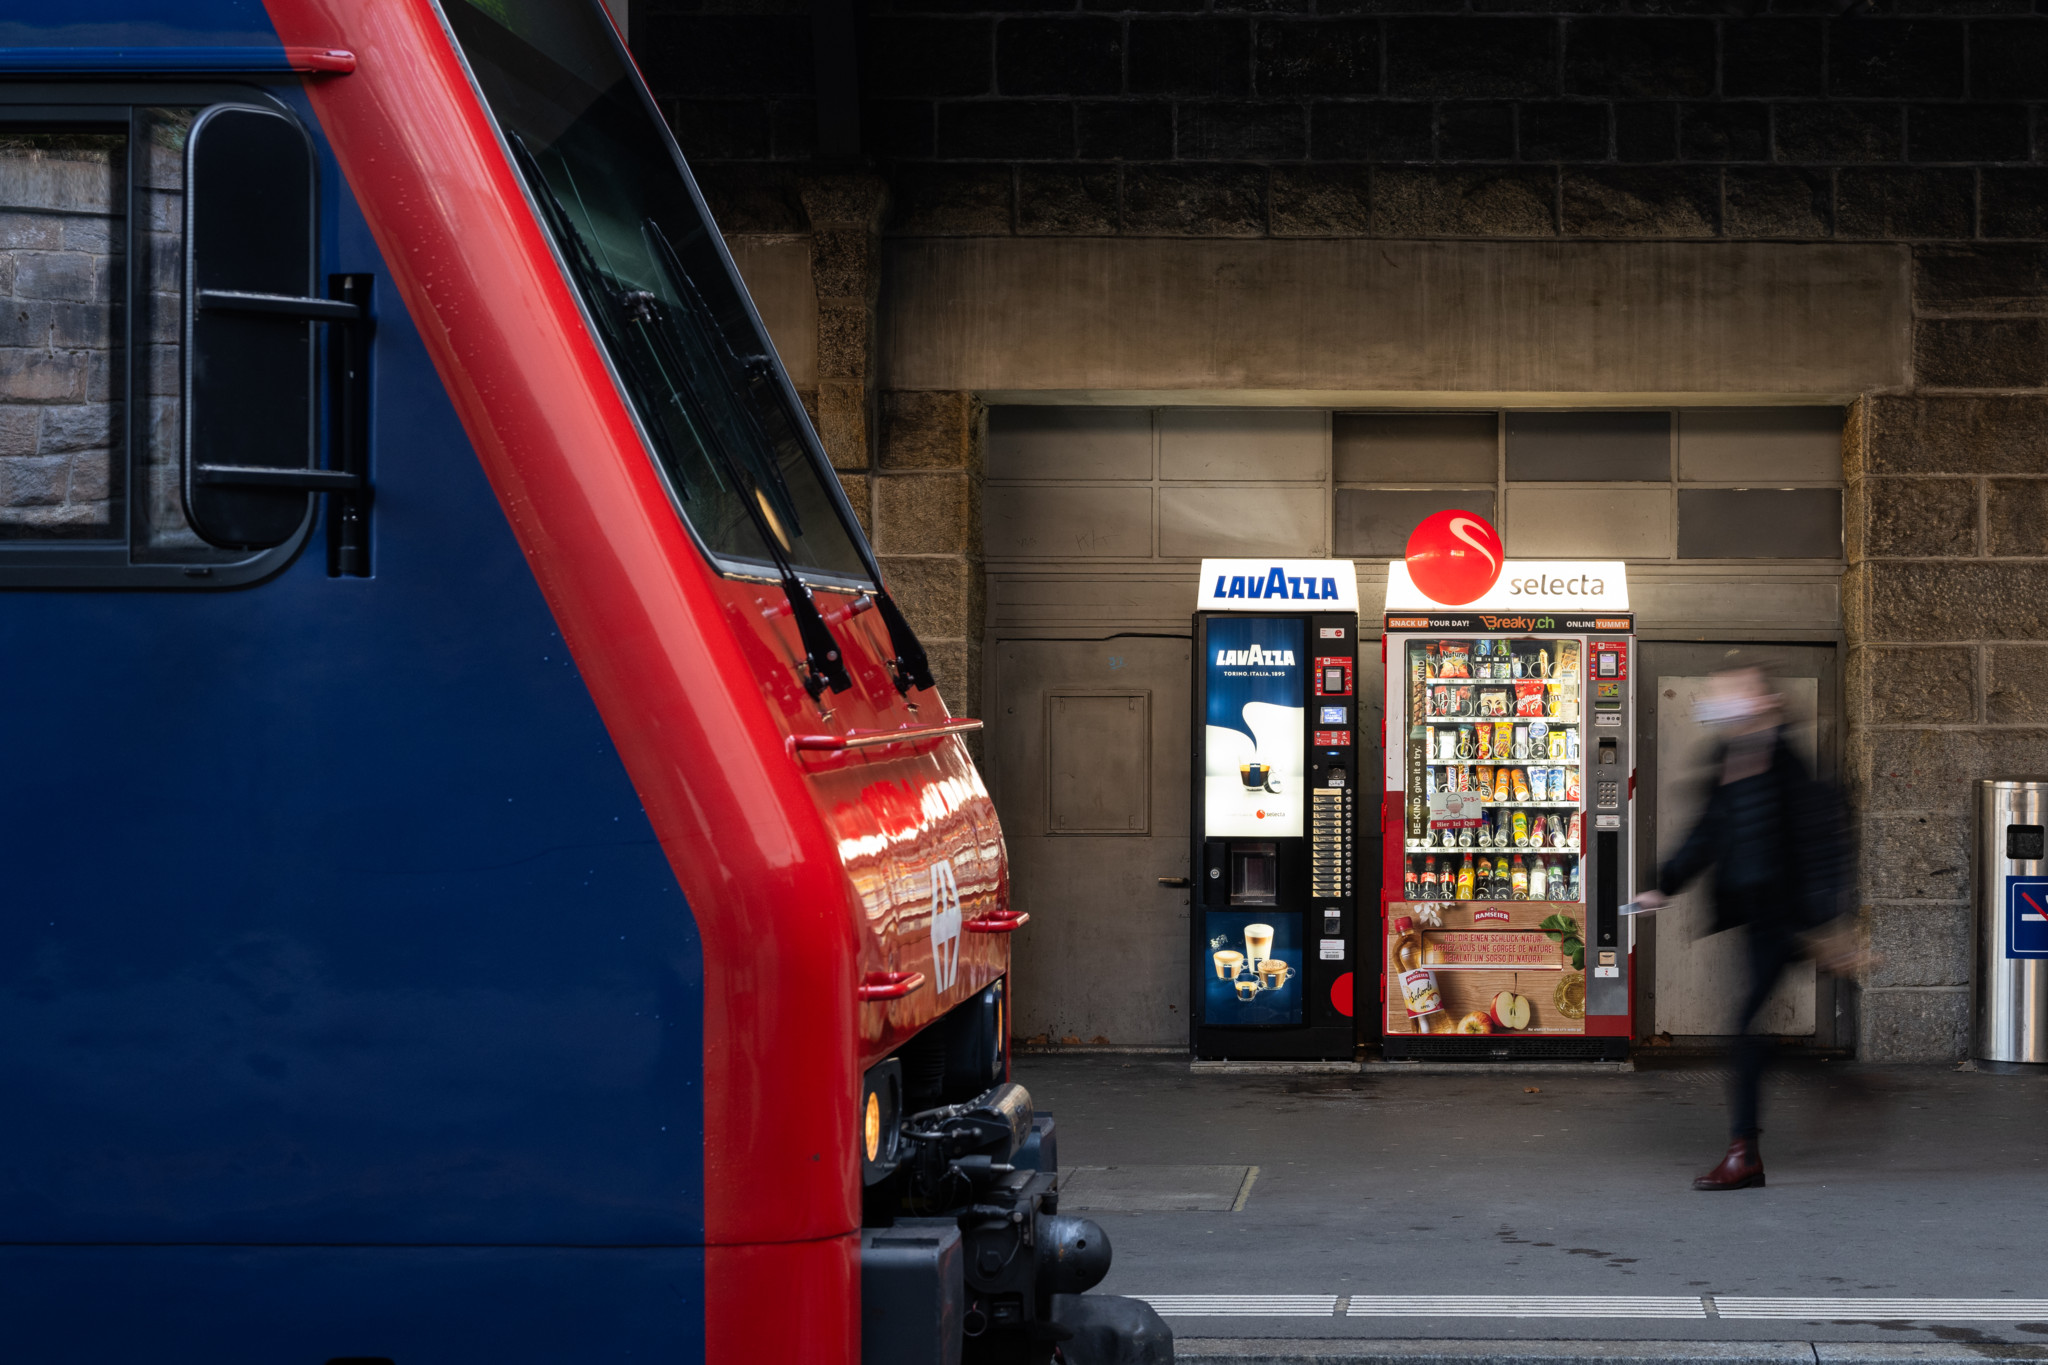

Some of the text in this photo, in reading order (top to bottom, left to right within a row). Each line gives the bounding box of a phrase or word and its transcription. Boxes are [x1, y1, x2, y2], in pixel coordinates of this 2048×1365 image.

[1213, 567, 1339, 600] LAVAZZA
[1509, 574, 1605, 596] selecta
[1390, 619, 1470, 628] SNACK UP YOUR DAY!
[1479, 615, 1555, 631] Breaky.ch
[1566, 620, 1629, 629] ONLINE YUMMY!
[1216, 644, 1296, 666] LAVAZZA
[1417, 660, 1425, 682] KIND
[1414, 773, 1422, 794] give
[1464, 819, 1476, 827] Qui
[1475, 911, 1509, 920] RAMSEIER
[1445, 934, 1456, 942] HOL
[1458, 934, 1468, 942] DIR
[1470, 934, 1489, 942] EINEN
[1491, 934, 1519, 943] SCHLUCK
[1477, 943, 1490, 952] UNE
[1518, 944, 1526, 953] DE
[1474, 954, 1483, 962] UN
[1485, 954, 1506, 963] SORSO
[1508, 954, 1515, 963] DI
